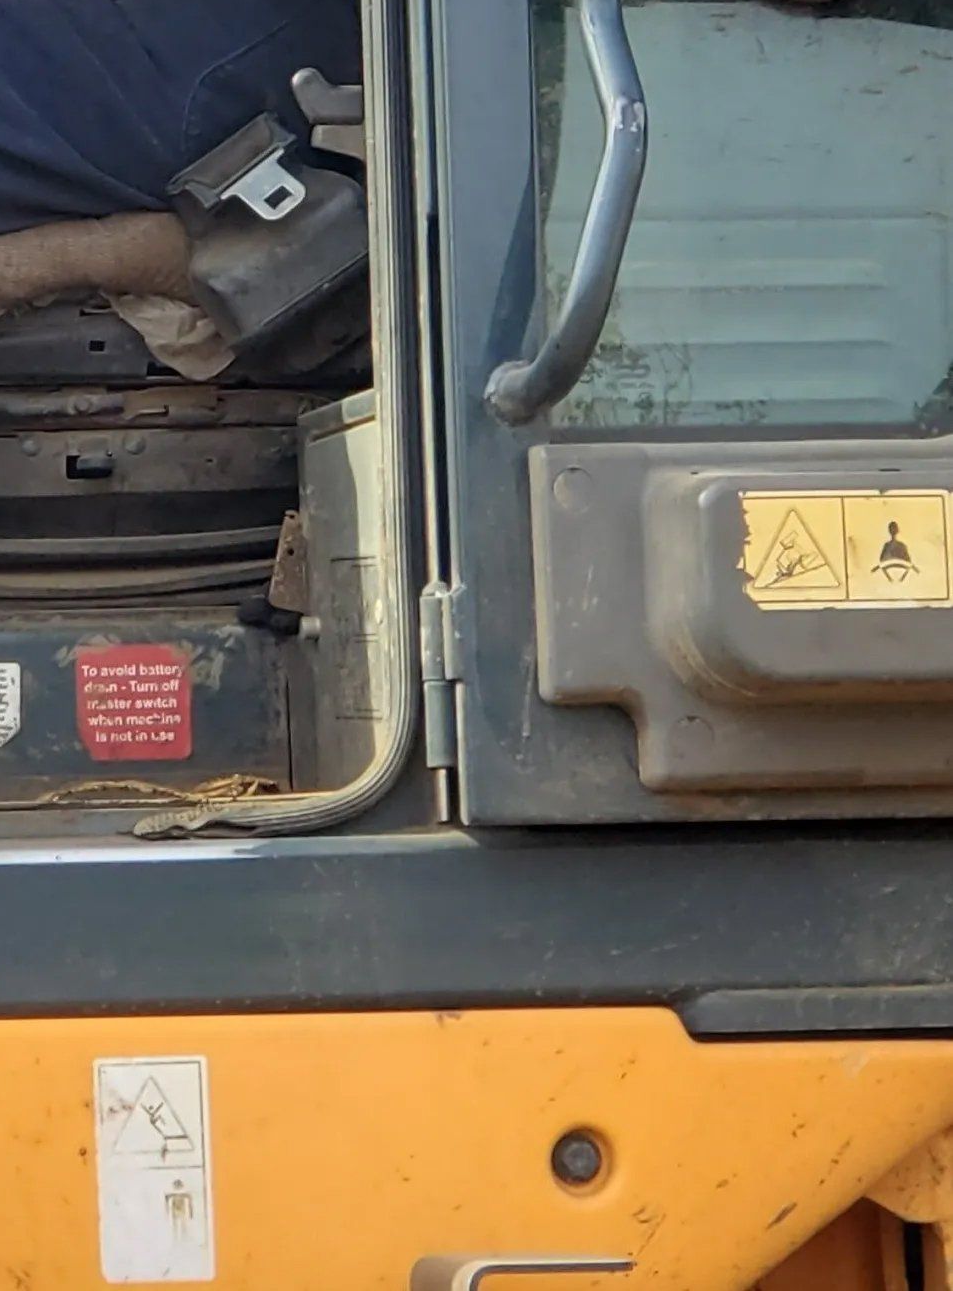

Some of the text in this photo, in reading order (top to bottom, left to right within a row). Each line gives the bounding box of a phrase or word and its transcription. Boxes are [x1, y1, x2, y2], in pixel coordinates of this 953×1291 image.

[82, 665, 98, 676] To
[101, 664, 136, 676] avoid
[129, 680, 158, 692] Turn
[162, 679, 180, 691] off
[135, 697, 177, 709] switch
[110, 731, 133, 742] not
[135, 730, 147, 741] in
